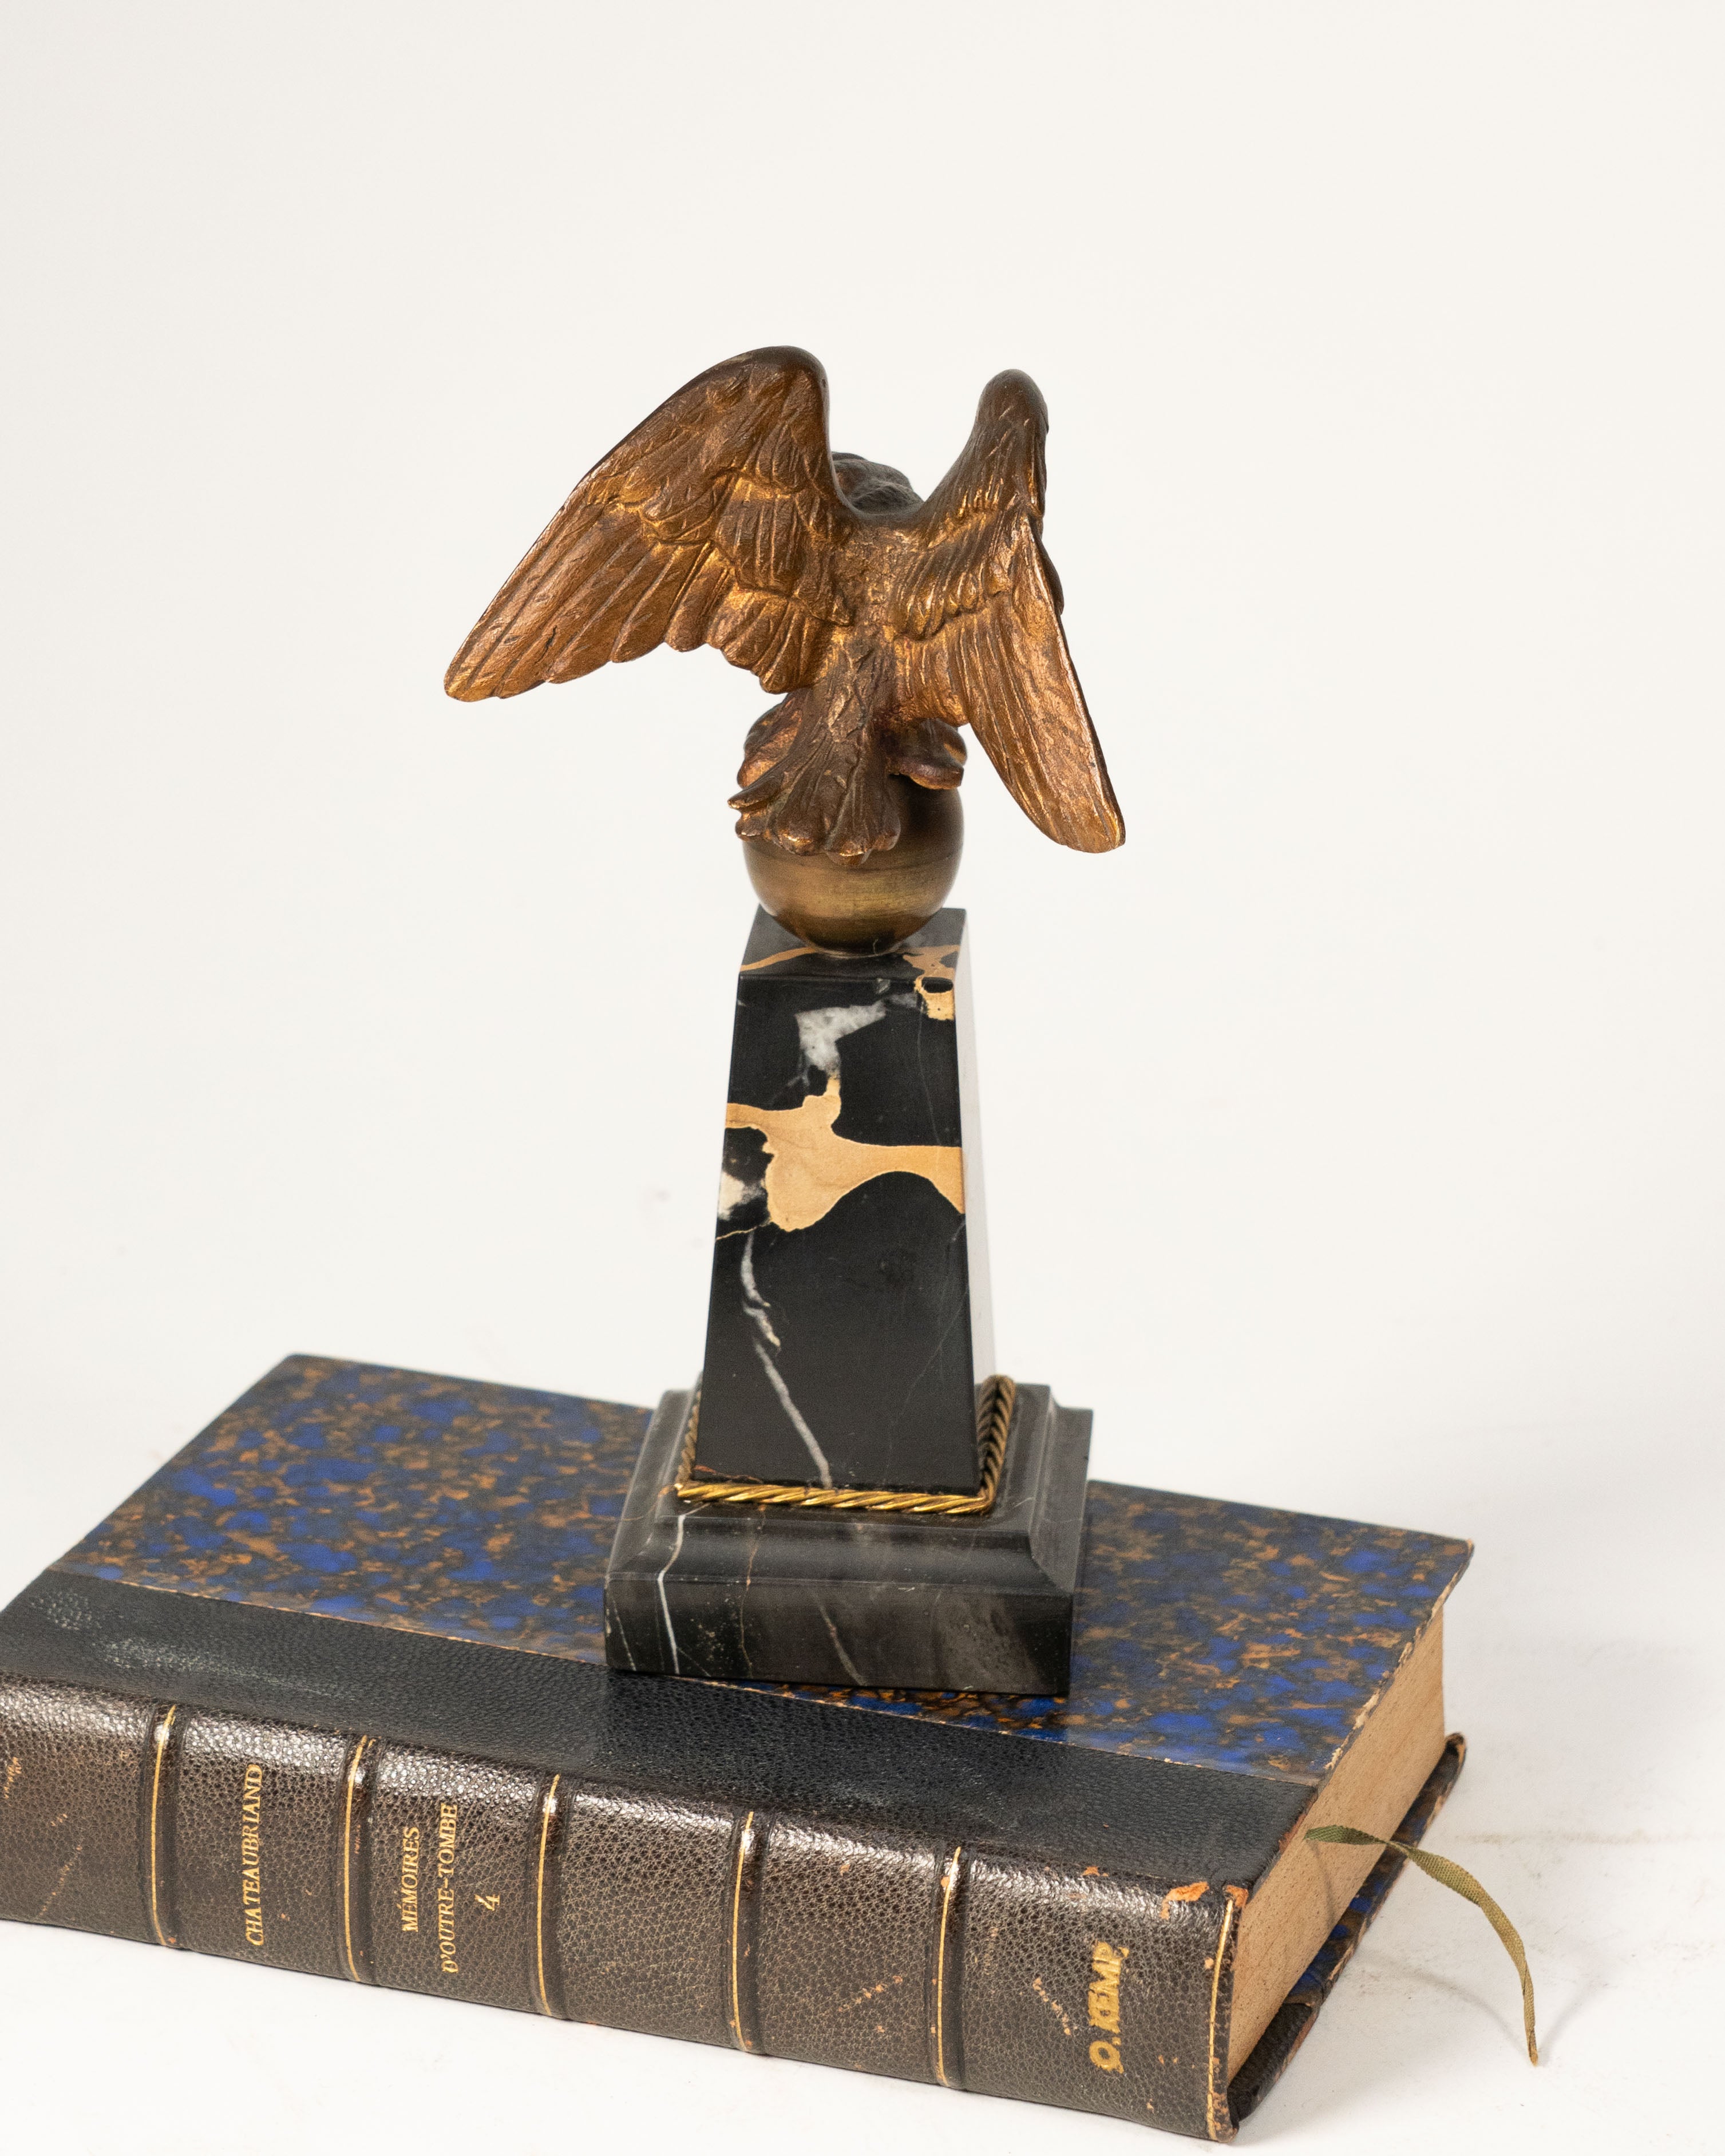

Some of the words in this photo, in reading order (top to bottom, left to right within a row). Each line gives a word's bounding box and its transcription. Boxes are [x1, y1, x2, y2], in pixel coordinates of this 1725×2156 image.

[242, 1763, 264, 1946] CHATEAUBRIAND
[397, 1826, 420, 1933] MÉMOIRES
[438, 1803, 458, 1973] D'OUTRE-TOMBE
[474, 1893, 500, 1911] 4
